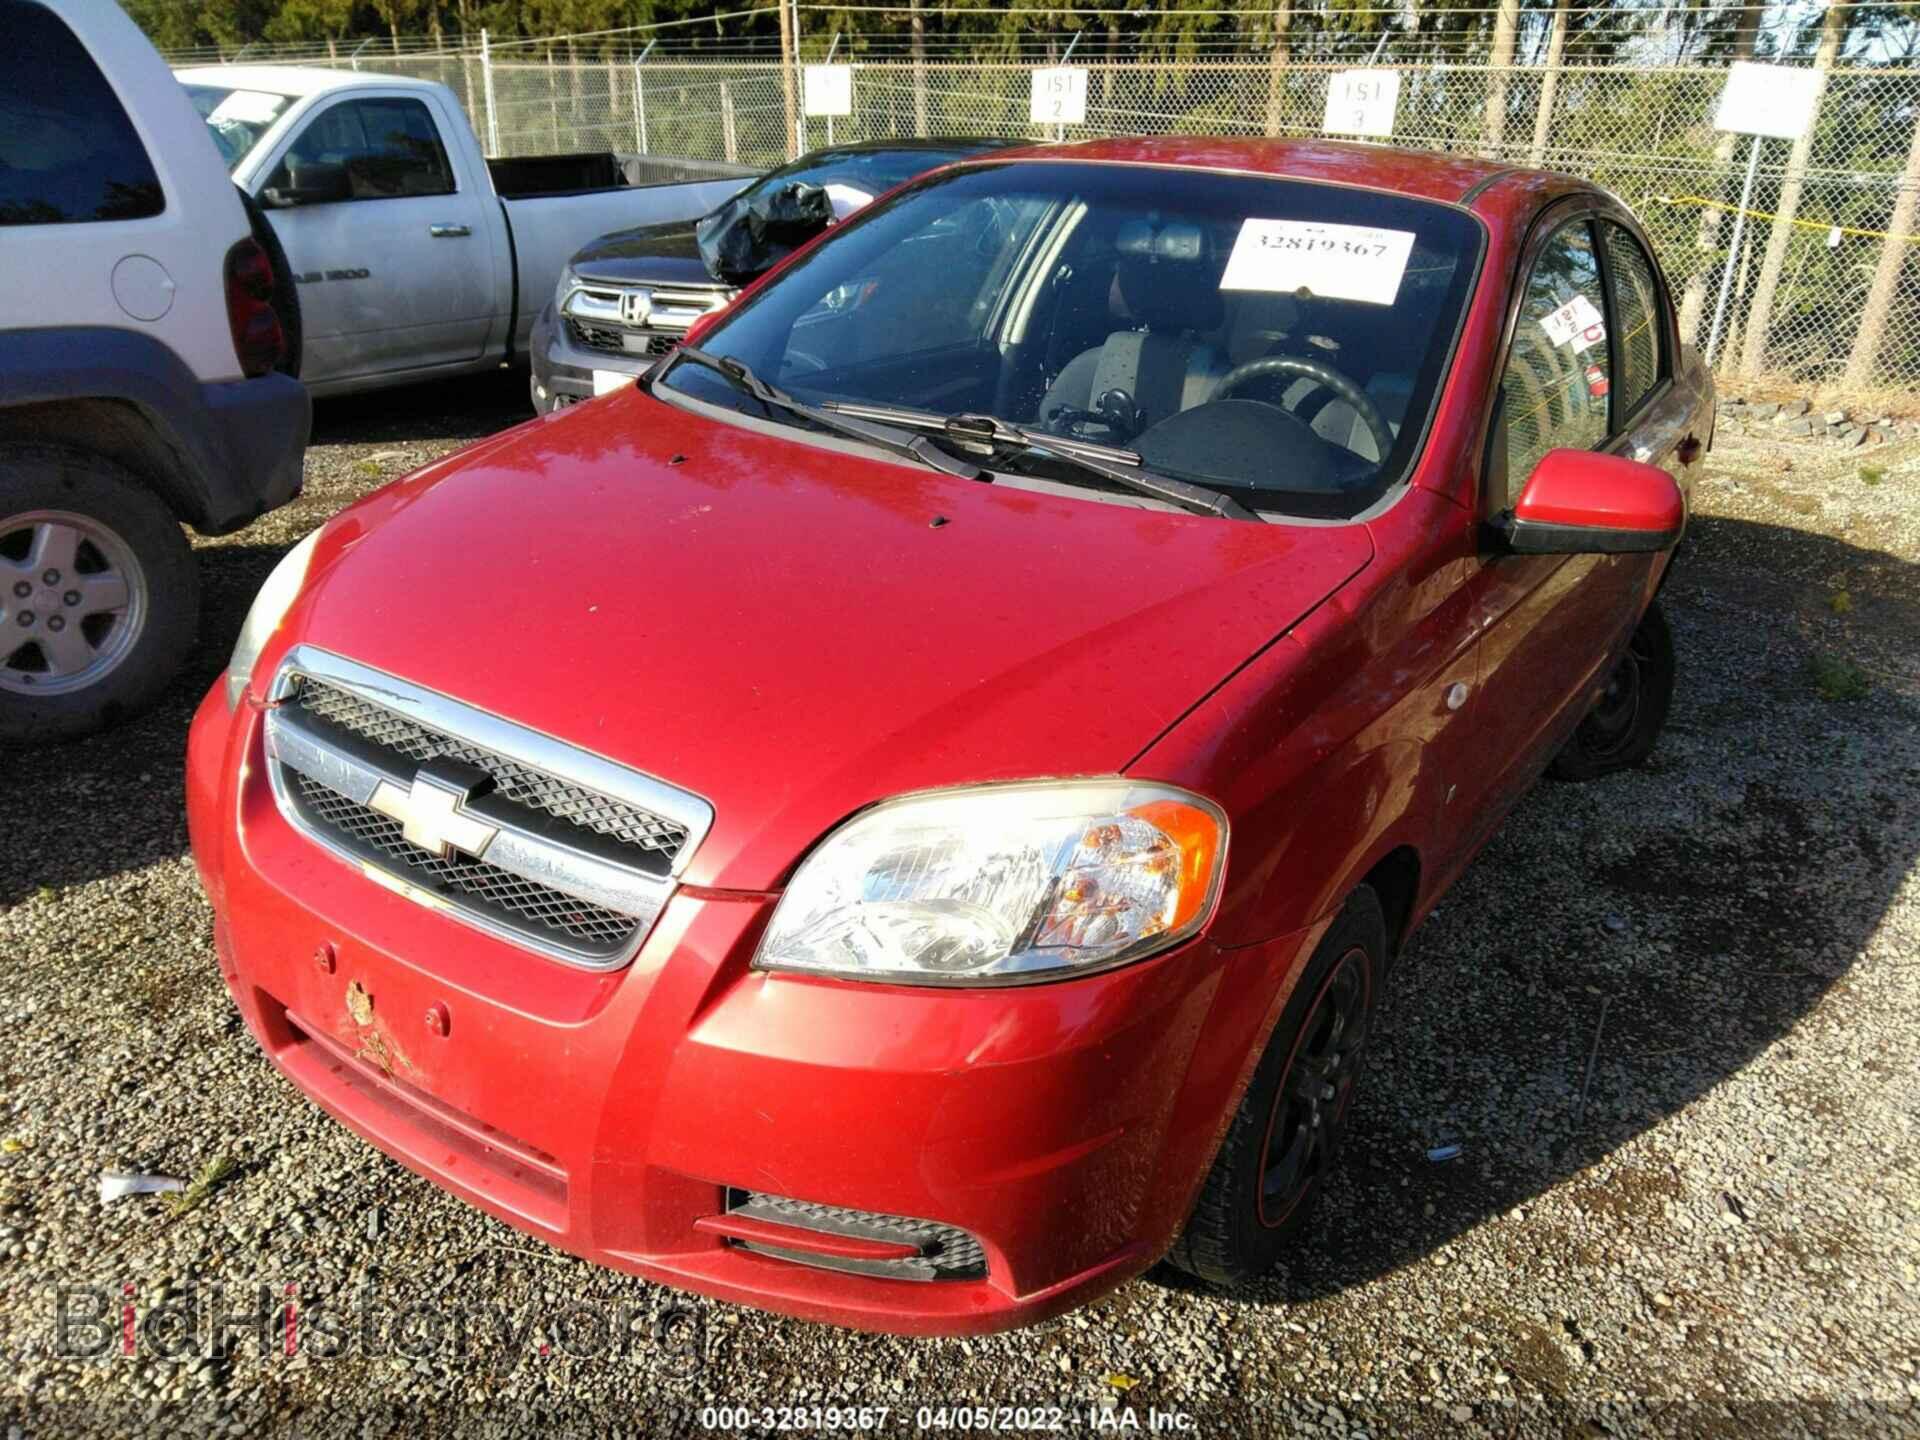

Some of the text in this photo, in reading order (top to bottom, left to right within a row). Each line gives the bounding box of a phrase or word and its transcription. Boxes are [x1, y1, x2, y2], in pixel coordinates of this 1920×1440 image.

[1053, 100, 1063, 117] 2
[1351, 109, 1365, 128] 3
[1258, 234, 1388, 258] 32819367
